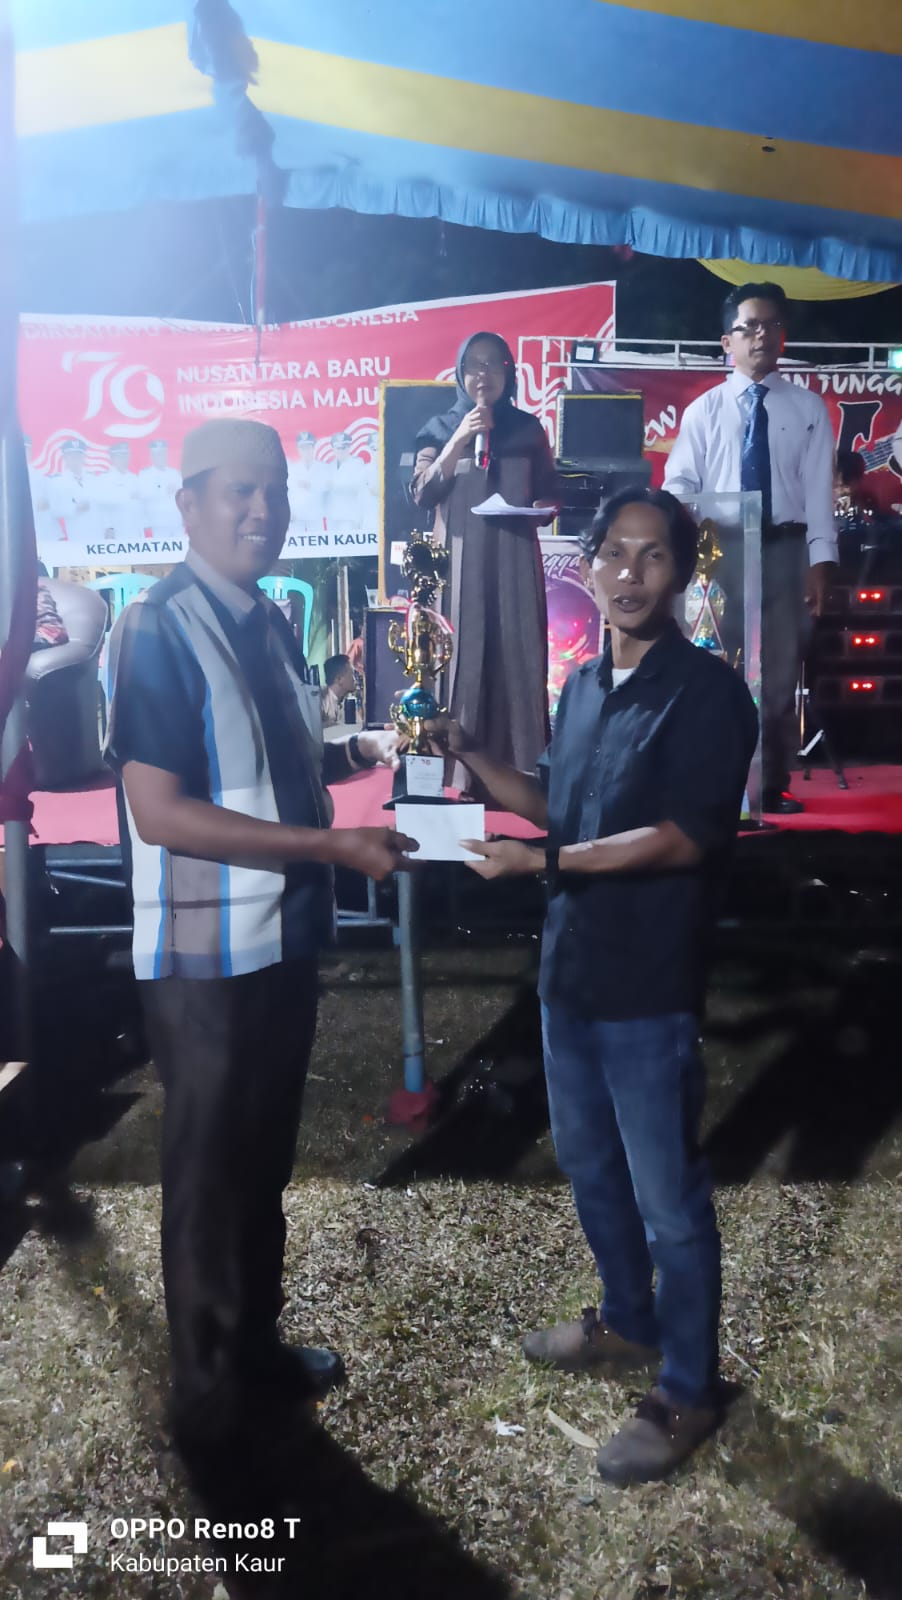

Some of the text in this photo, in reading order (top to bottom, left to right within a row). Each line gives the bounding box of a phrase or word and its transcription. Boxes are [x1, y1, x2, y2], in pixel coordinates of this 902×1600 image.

[176, 356, 391, 385] NUSANTARA BARU
[62, 351, 164, 439] 79
[177, 386, 379, 416] INDONESIA MAJU
[86, 540, 183, 556] KECAMATAN
[334, 533, 378, 547] KAUR
